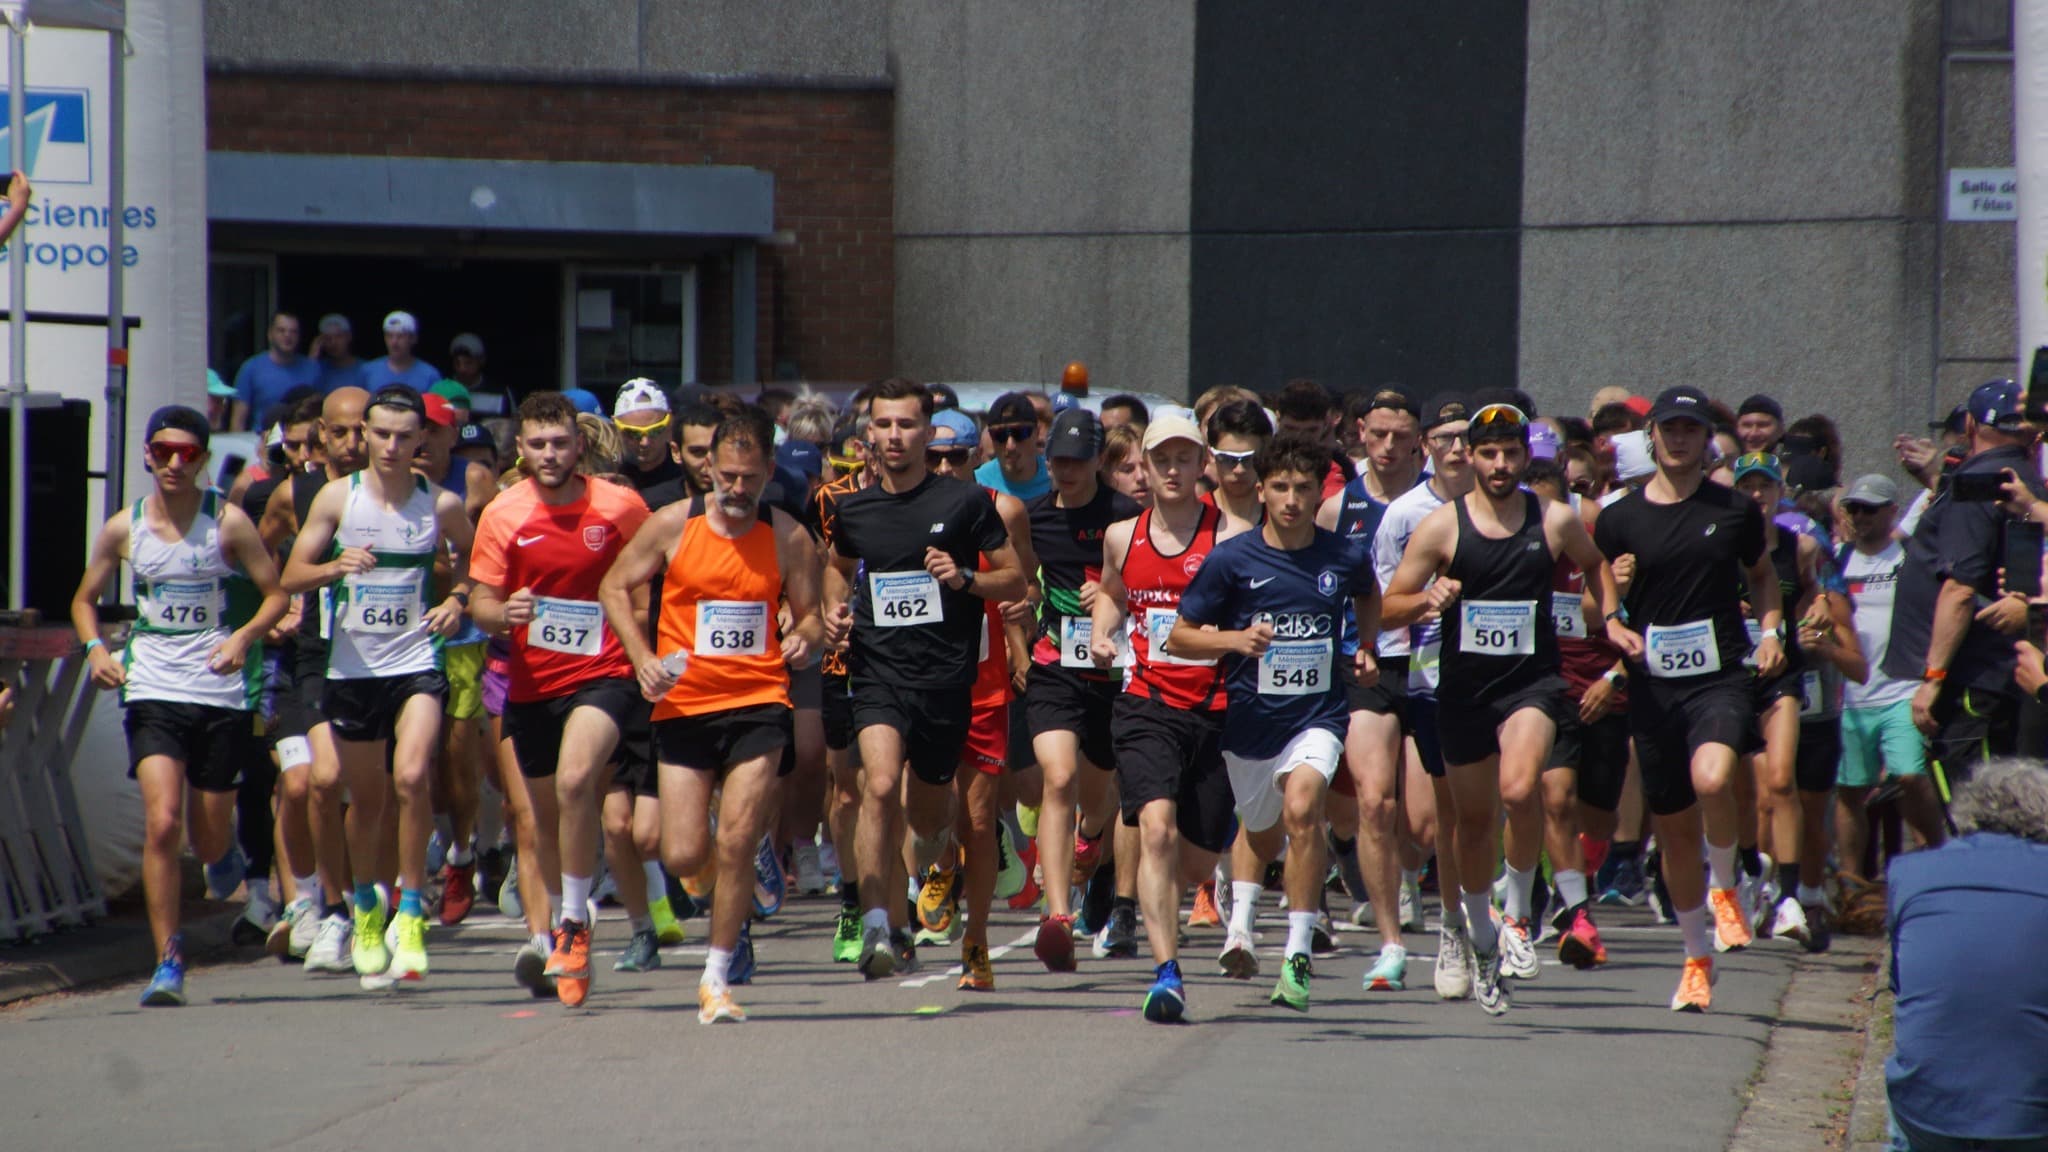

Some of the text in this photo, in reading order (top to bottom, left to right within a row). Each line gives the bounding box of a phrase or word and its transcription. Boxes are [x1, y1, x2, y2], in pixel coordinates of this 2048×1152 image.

[1960, 179, 1996, 194] Salle
[1973, 197, 2013, 212] Fêtes
[161, 606, 207, 622] 476
[363, 608, 408, 626] 646
[884, 598, 929, 619] 462
[542, 625, 588, 647] 637
[711, 630, 754, 648] 638
[1475, 629, 1519, 648] 501
[1661, 650, 1705, 671] 520
[1272, 669, 1319, 687] 548
